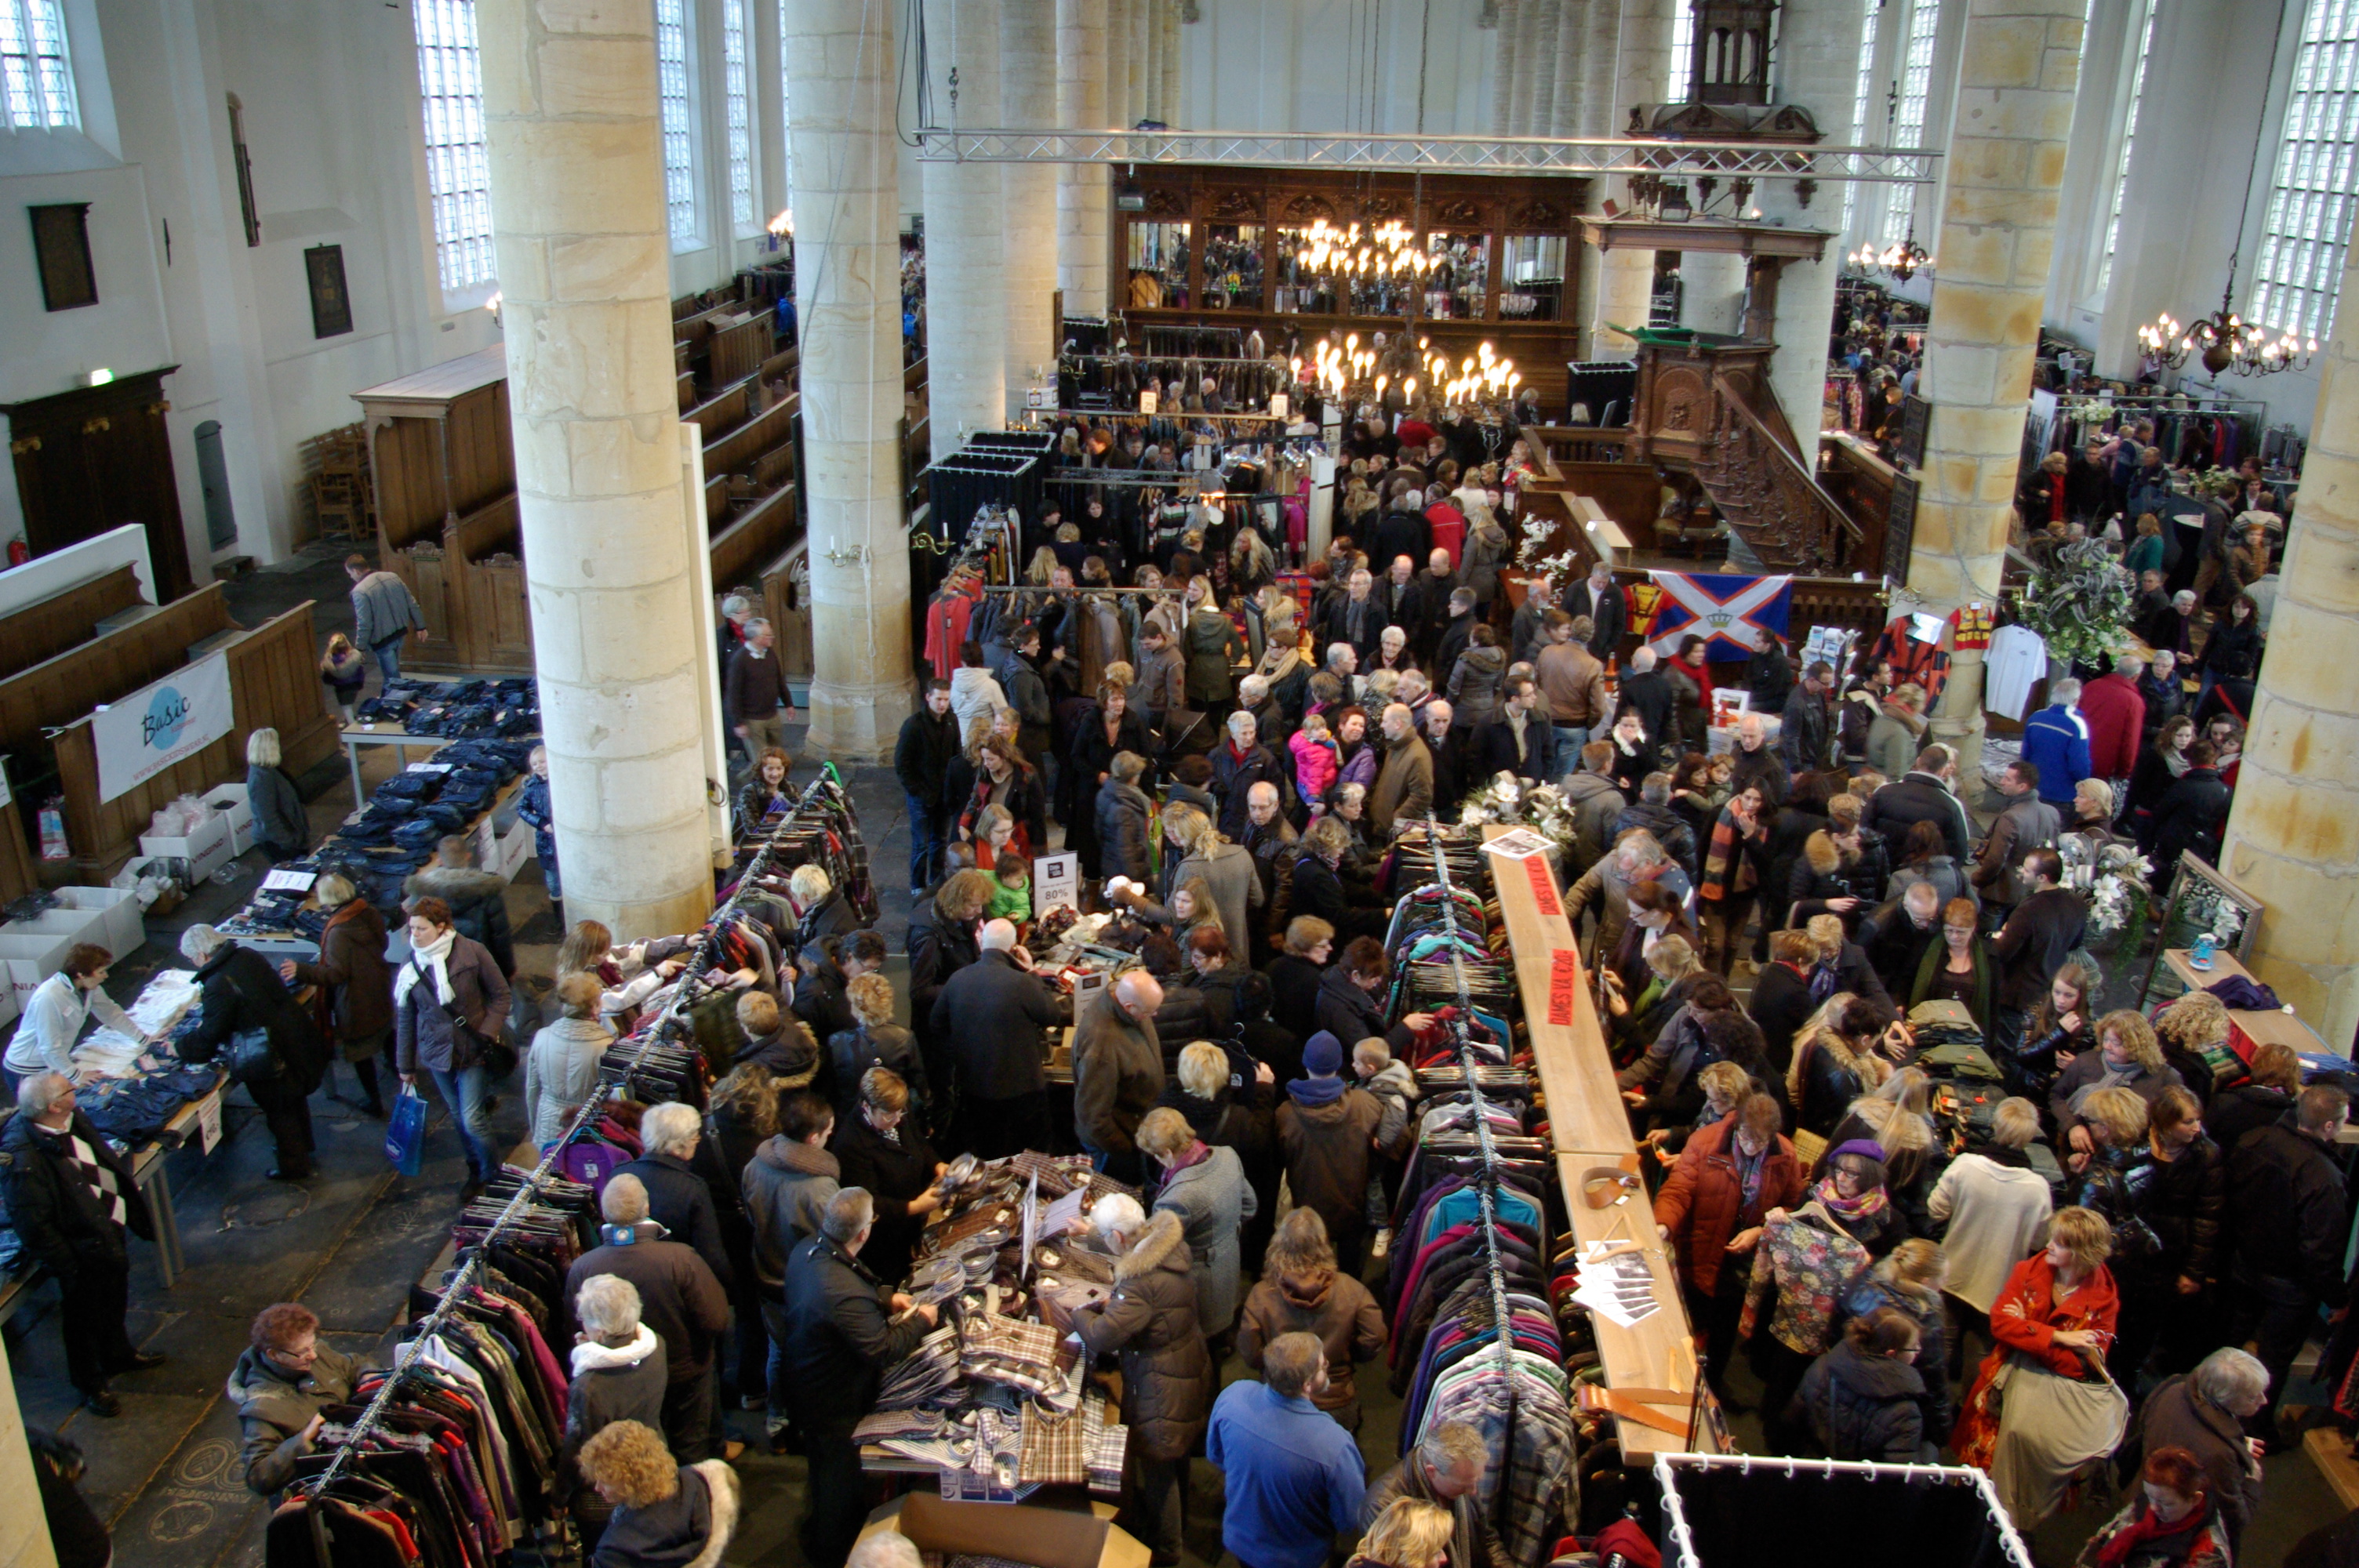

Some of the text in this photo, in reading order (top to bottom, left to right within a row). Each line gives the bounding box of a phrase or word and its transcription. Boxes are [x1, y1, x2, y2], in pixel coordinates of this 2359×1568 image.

[140, 696, 191, 747] Basic
[1045, 887, 1069, 900] 80%
[1550, 993, 1572, 1025] DAMES
